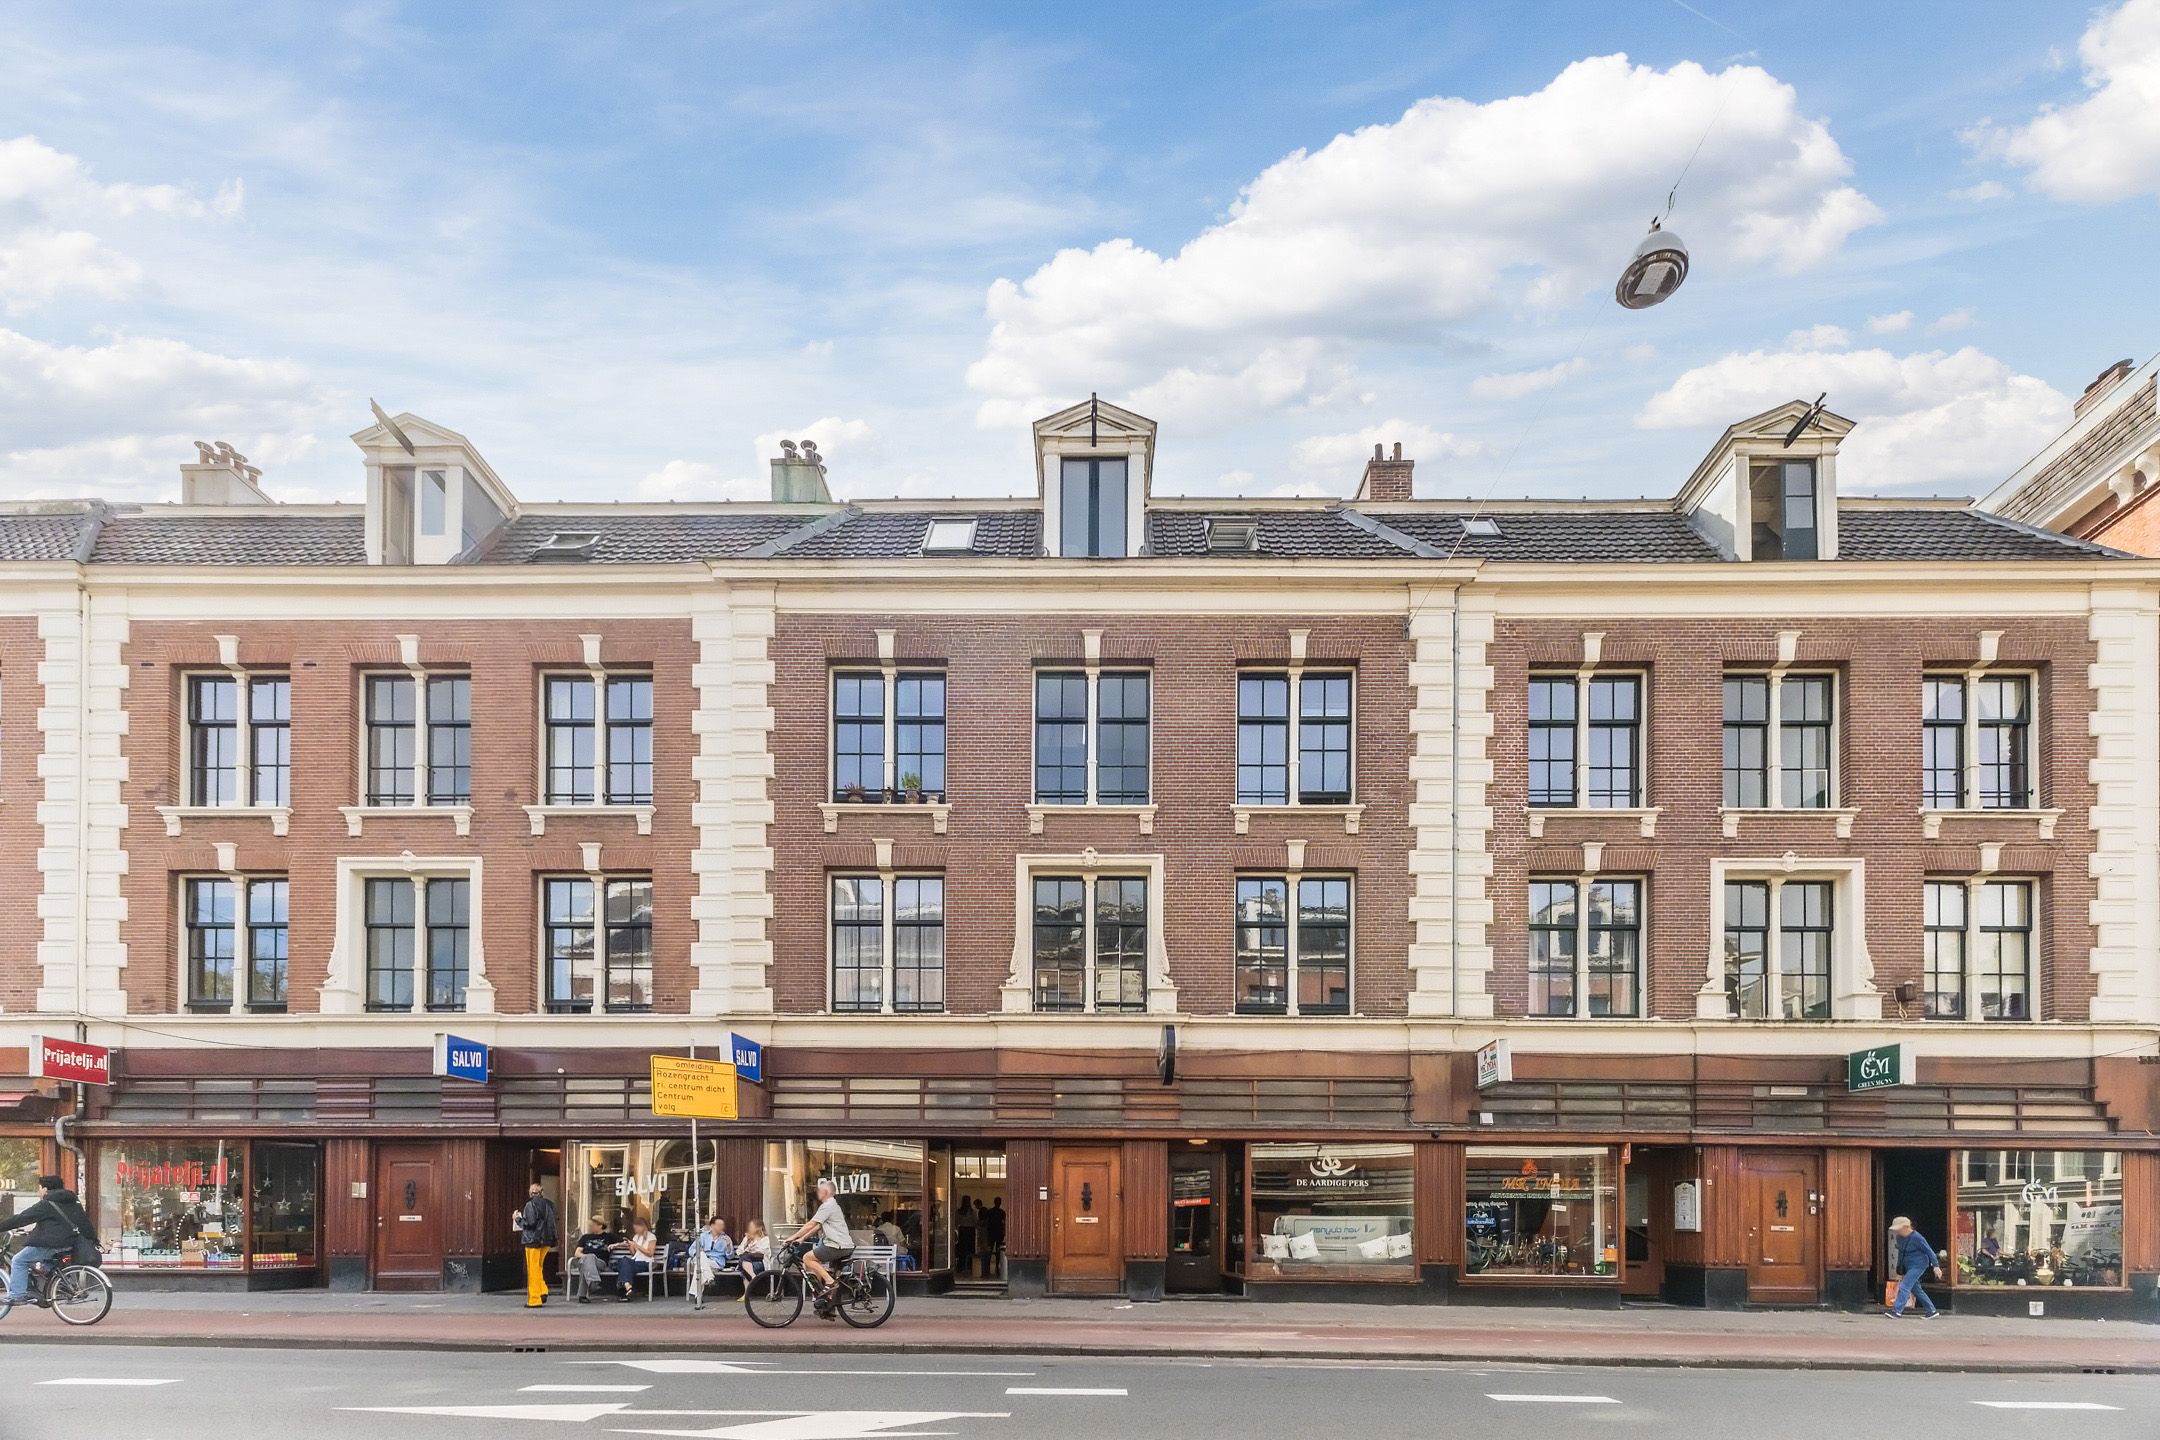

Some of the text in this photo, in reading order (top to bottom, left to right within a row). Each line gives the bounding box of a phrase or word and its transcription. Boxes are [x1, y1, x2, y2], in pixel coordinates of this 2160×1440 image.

[44, 1047, 108, 1071] Prijatelji.nl
[452, 1050, 482, 1068] SALVO
[735, 1049, 757, 1067] SALVO
[675, 1061, 714, 1073] omleiding
[656, 1070, 709, 1081] Rozengracht
[668, 1083, 703, 1092] centrum
[705, 1084, 726, 1093] dicht
[656, 1092, 694, 1101] Centrum
[658, 1103, 676, 1112] volg
[116, 1157, 228, 1190] Prijatelji.nl
[615, 1173, 668, 1196] SALVO
[1296, 1179, 1369, 1187] DE AARDIGE PERS
